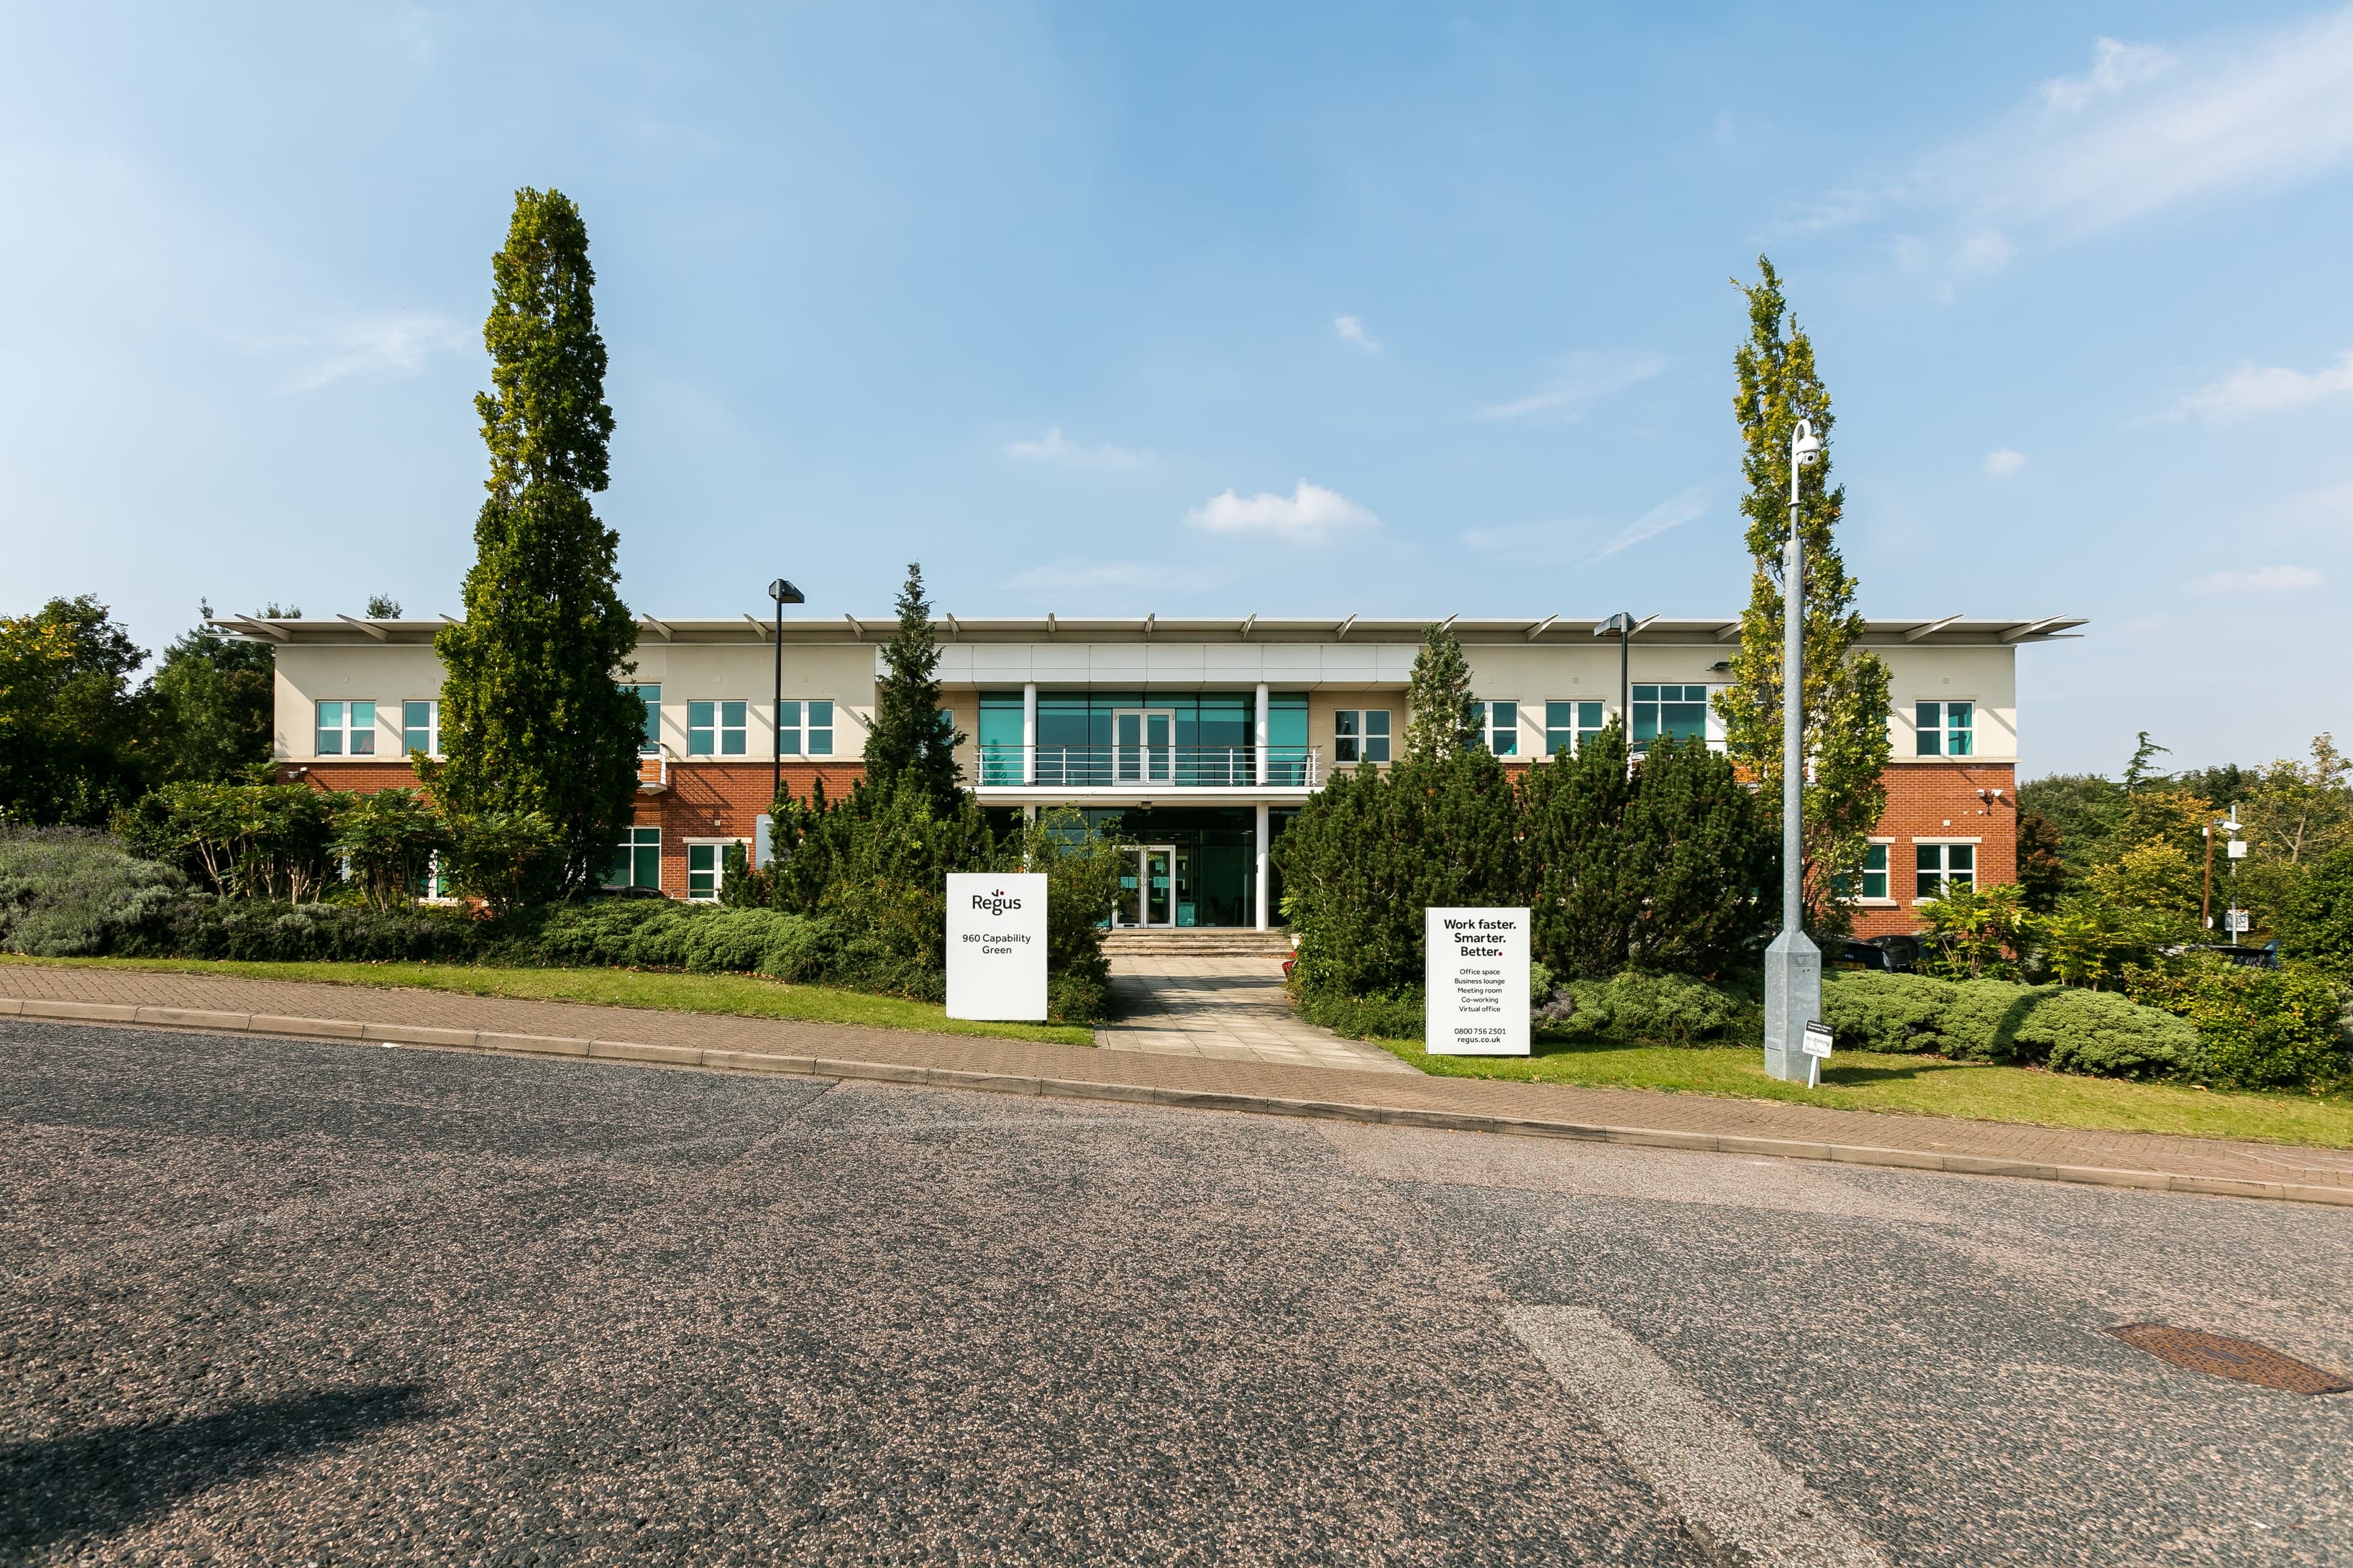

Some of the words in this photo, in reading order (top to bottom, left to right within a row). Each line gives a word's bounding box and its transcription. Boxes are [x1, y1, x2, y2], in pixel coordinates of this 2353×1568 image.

[972, 889, 1022, 916] Regus
[1443, 919, 1476, 930] Work
[1478, 919, 1517, 930] faster.
[962, 934, 981, 943] 960
[982, 933, 1031, 945] Capability
[1453, 932, 1507, 943] Smarter.
[982, 945, 1013, 954] Green
[1461, 946, 1503, 957] Better.
[1457, 1036, 1501, 1045] regus.co.uk
